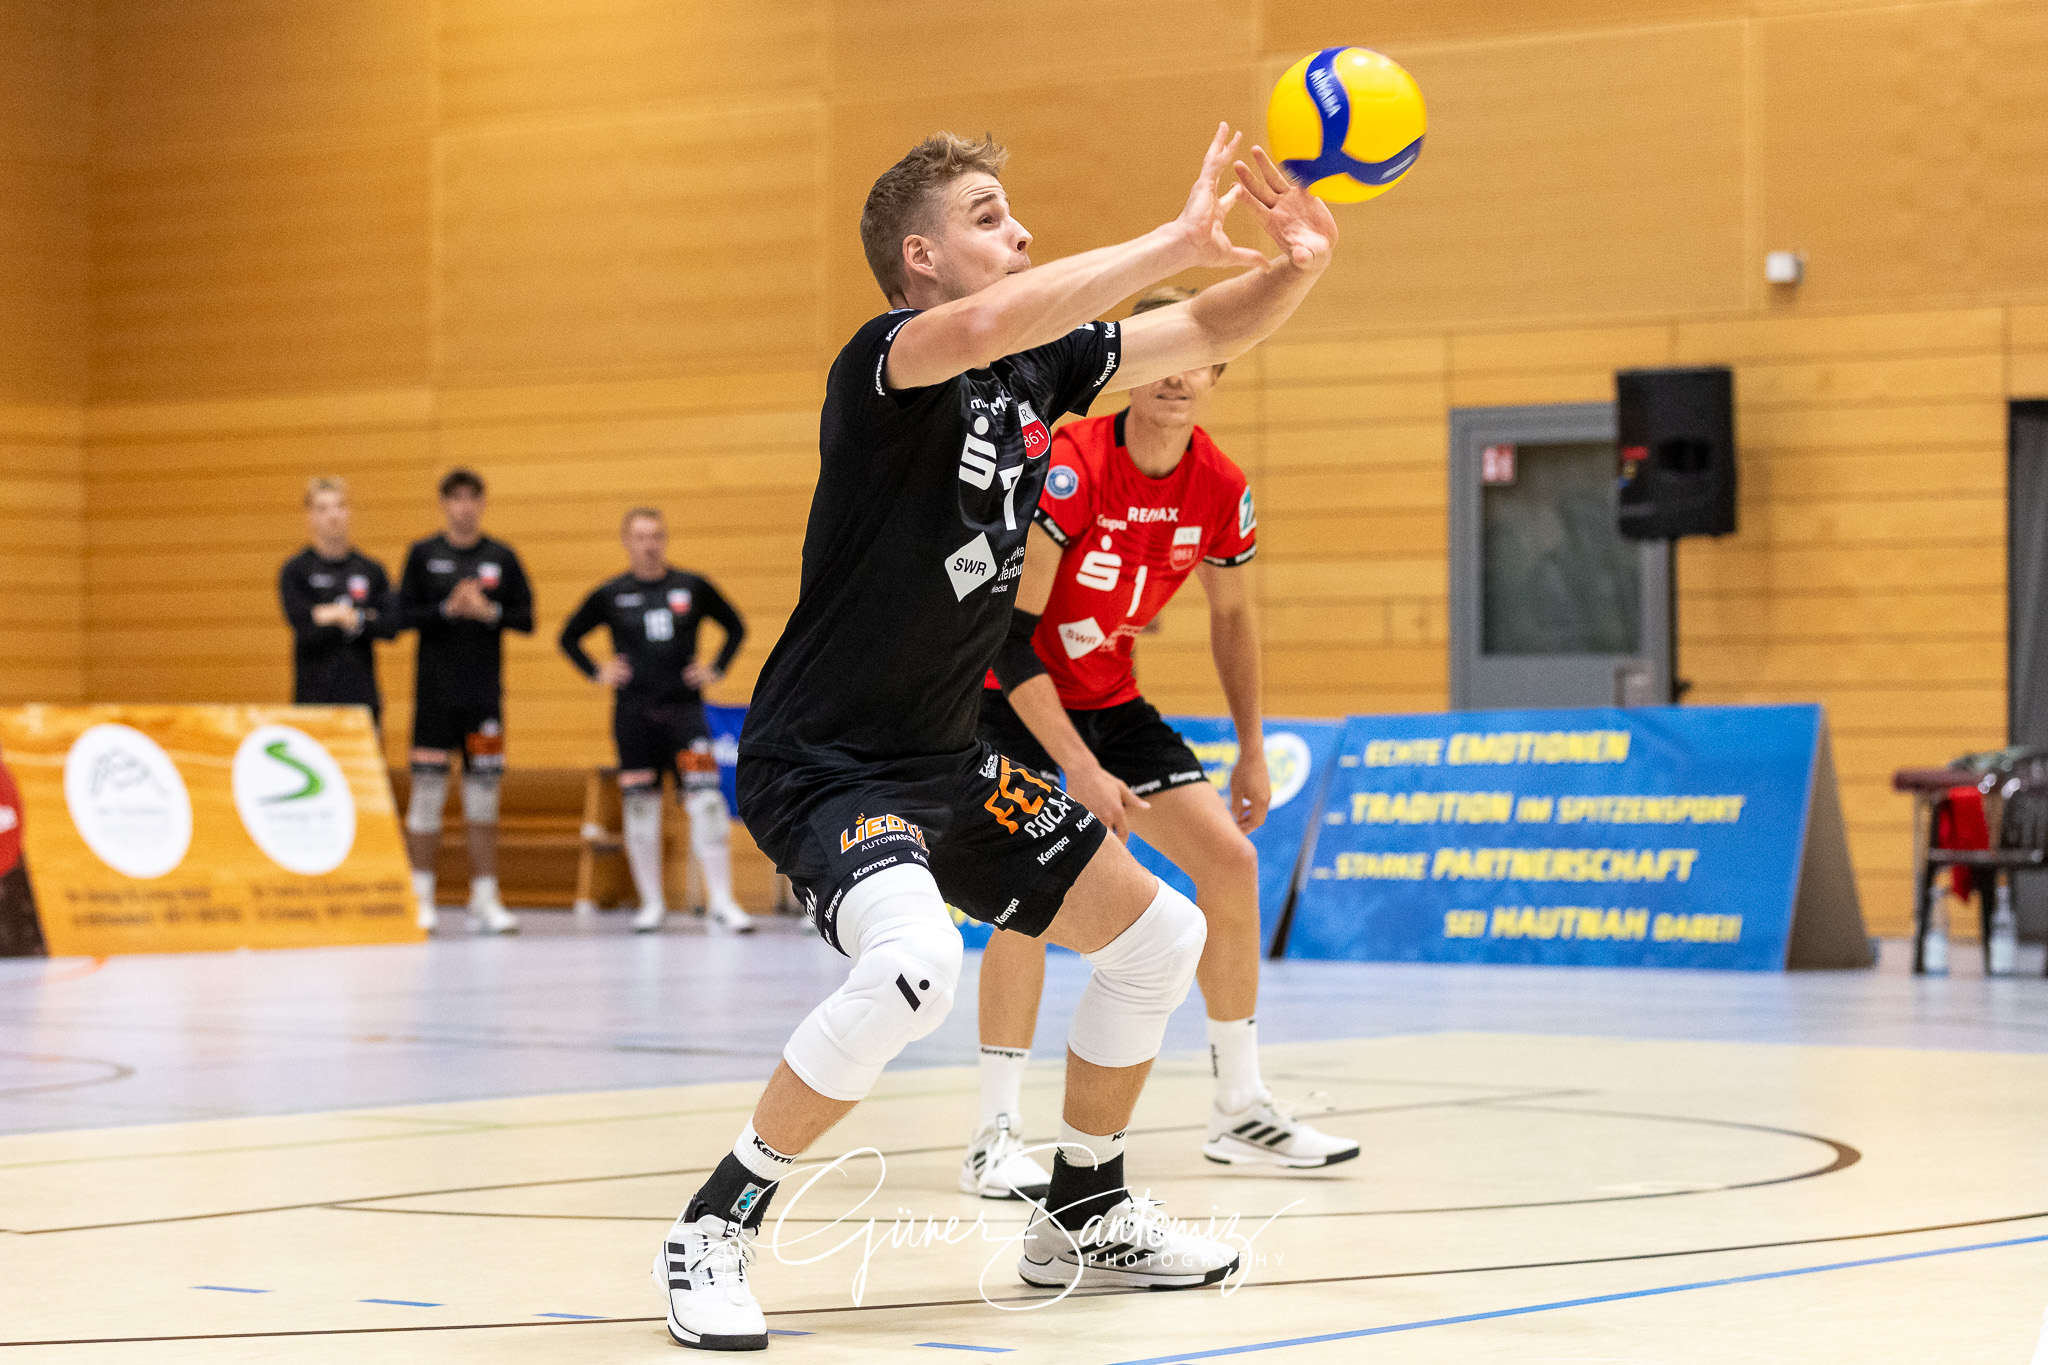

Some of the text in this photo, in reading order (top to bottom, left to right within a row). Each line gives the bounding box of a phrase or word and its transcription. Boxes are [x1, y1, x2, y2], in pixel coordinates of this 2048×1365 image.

[998, 463, 1024, 531] 7
[953, 557, 988, 577] SWR
[1447, 731, 1631, 765] EMOTIONEN
[1350, 792, 1515, 825] TRADITION
[1036, 835, 1071, 866] Kempa
[1432, 848, 1698, 882] PARTNERSCHAFT
[852, 855, 898, 881] Kempa
[824, 888, 843, 923] Kempa
[993, 897, 1020, 925] Kempa
[1490, 905, 1649, 940] HAUTNAH
